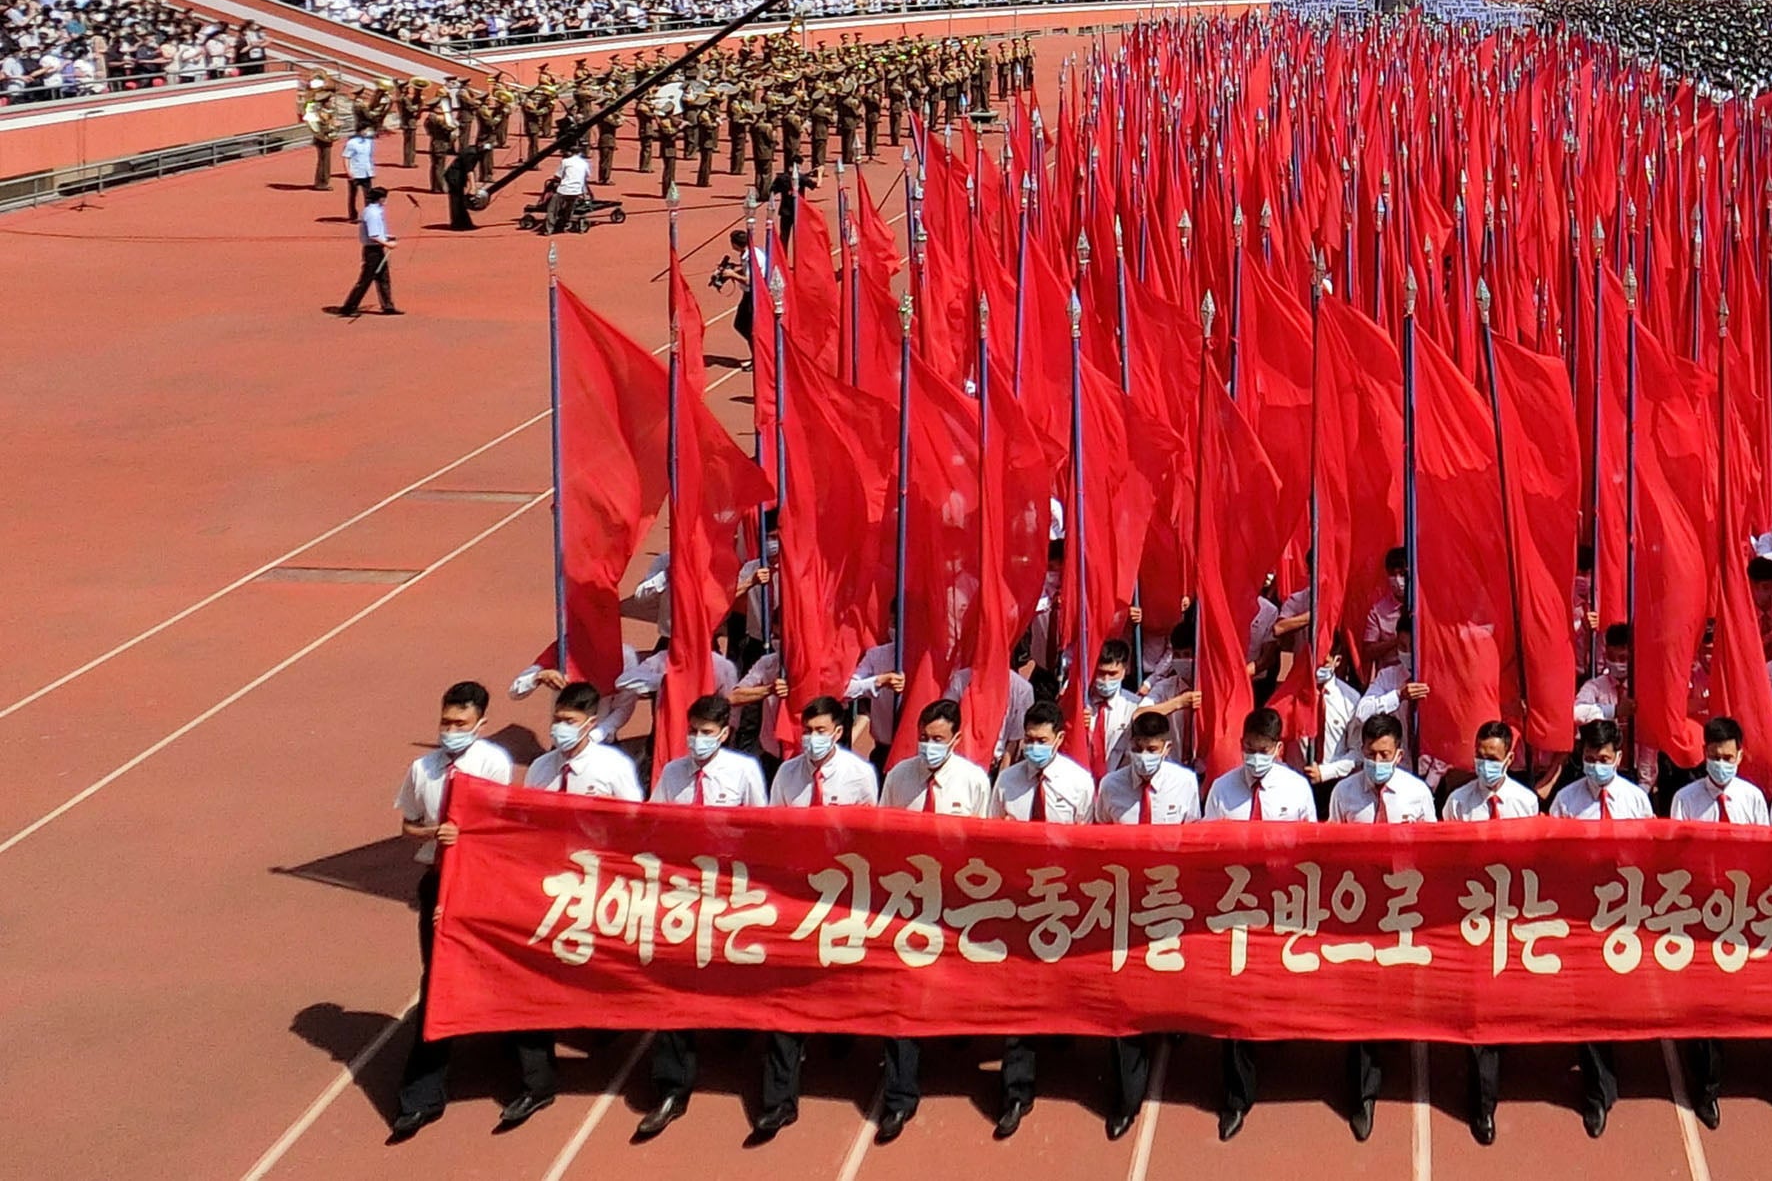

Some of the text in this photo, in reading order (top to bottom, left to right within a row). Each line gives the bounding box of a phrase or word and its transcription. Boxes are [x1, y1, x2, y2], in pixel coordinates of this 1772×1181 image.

[527, 849, 778, 968] 경애하는
[791, 852, 1194, 972] 김정은동지를
[1206, 861, 1432, 976] 수반으로
[1458, 864, 1569, 978] 하는
